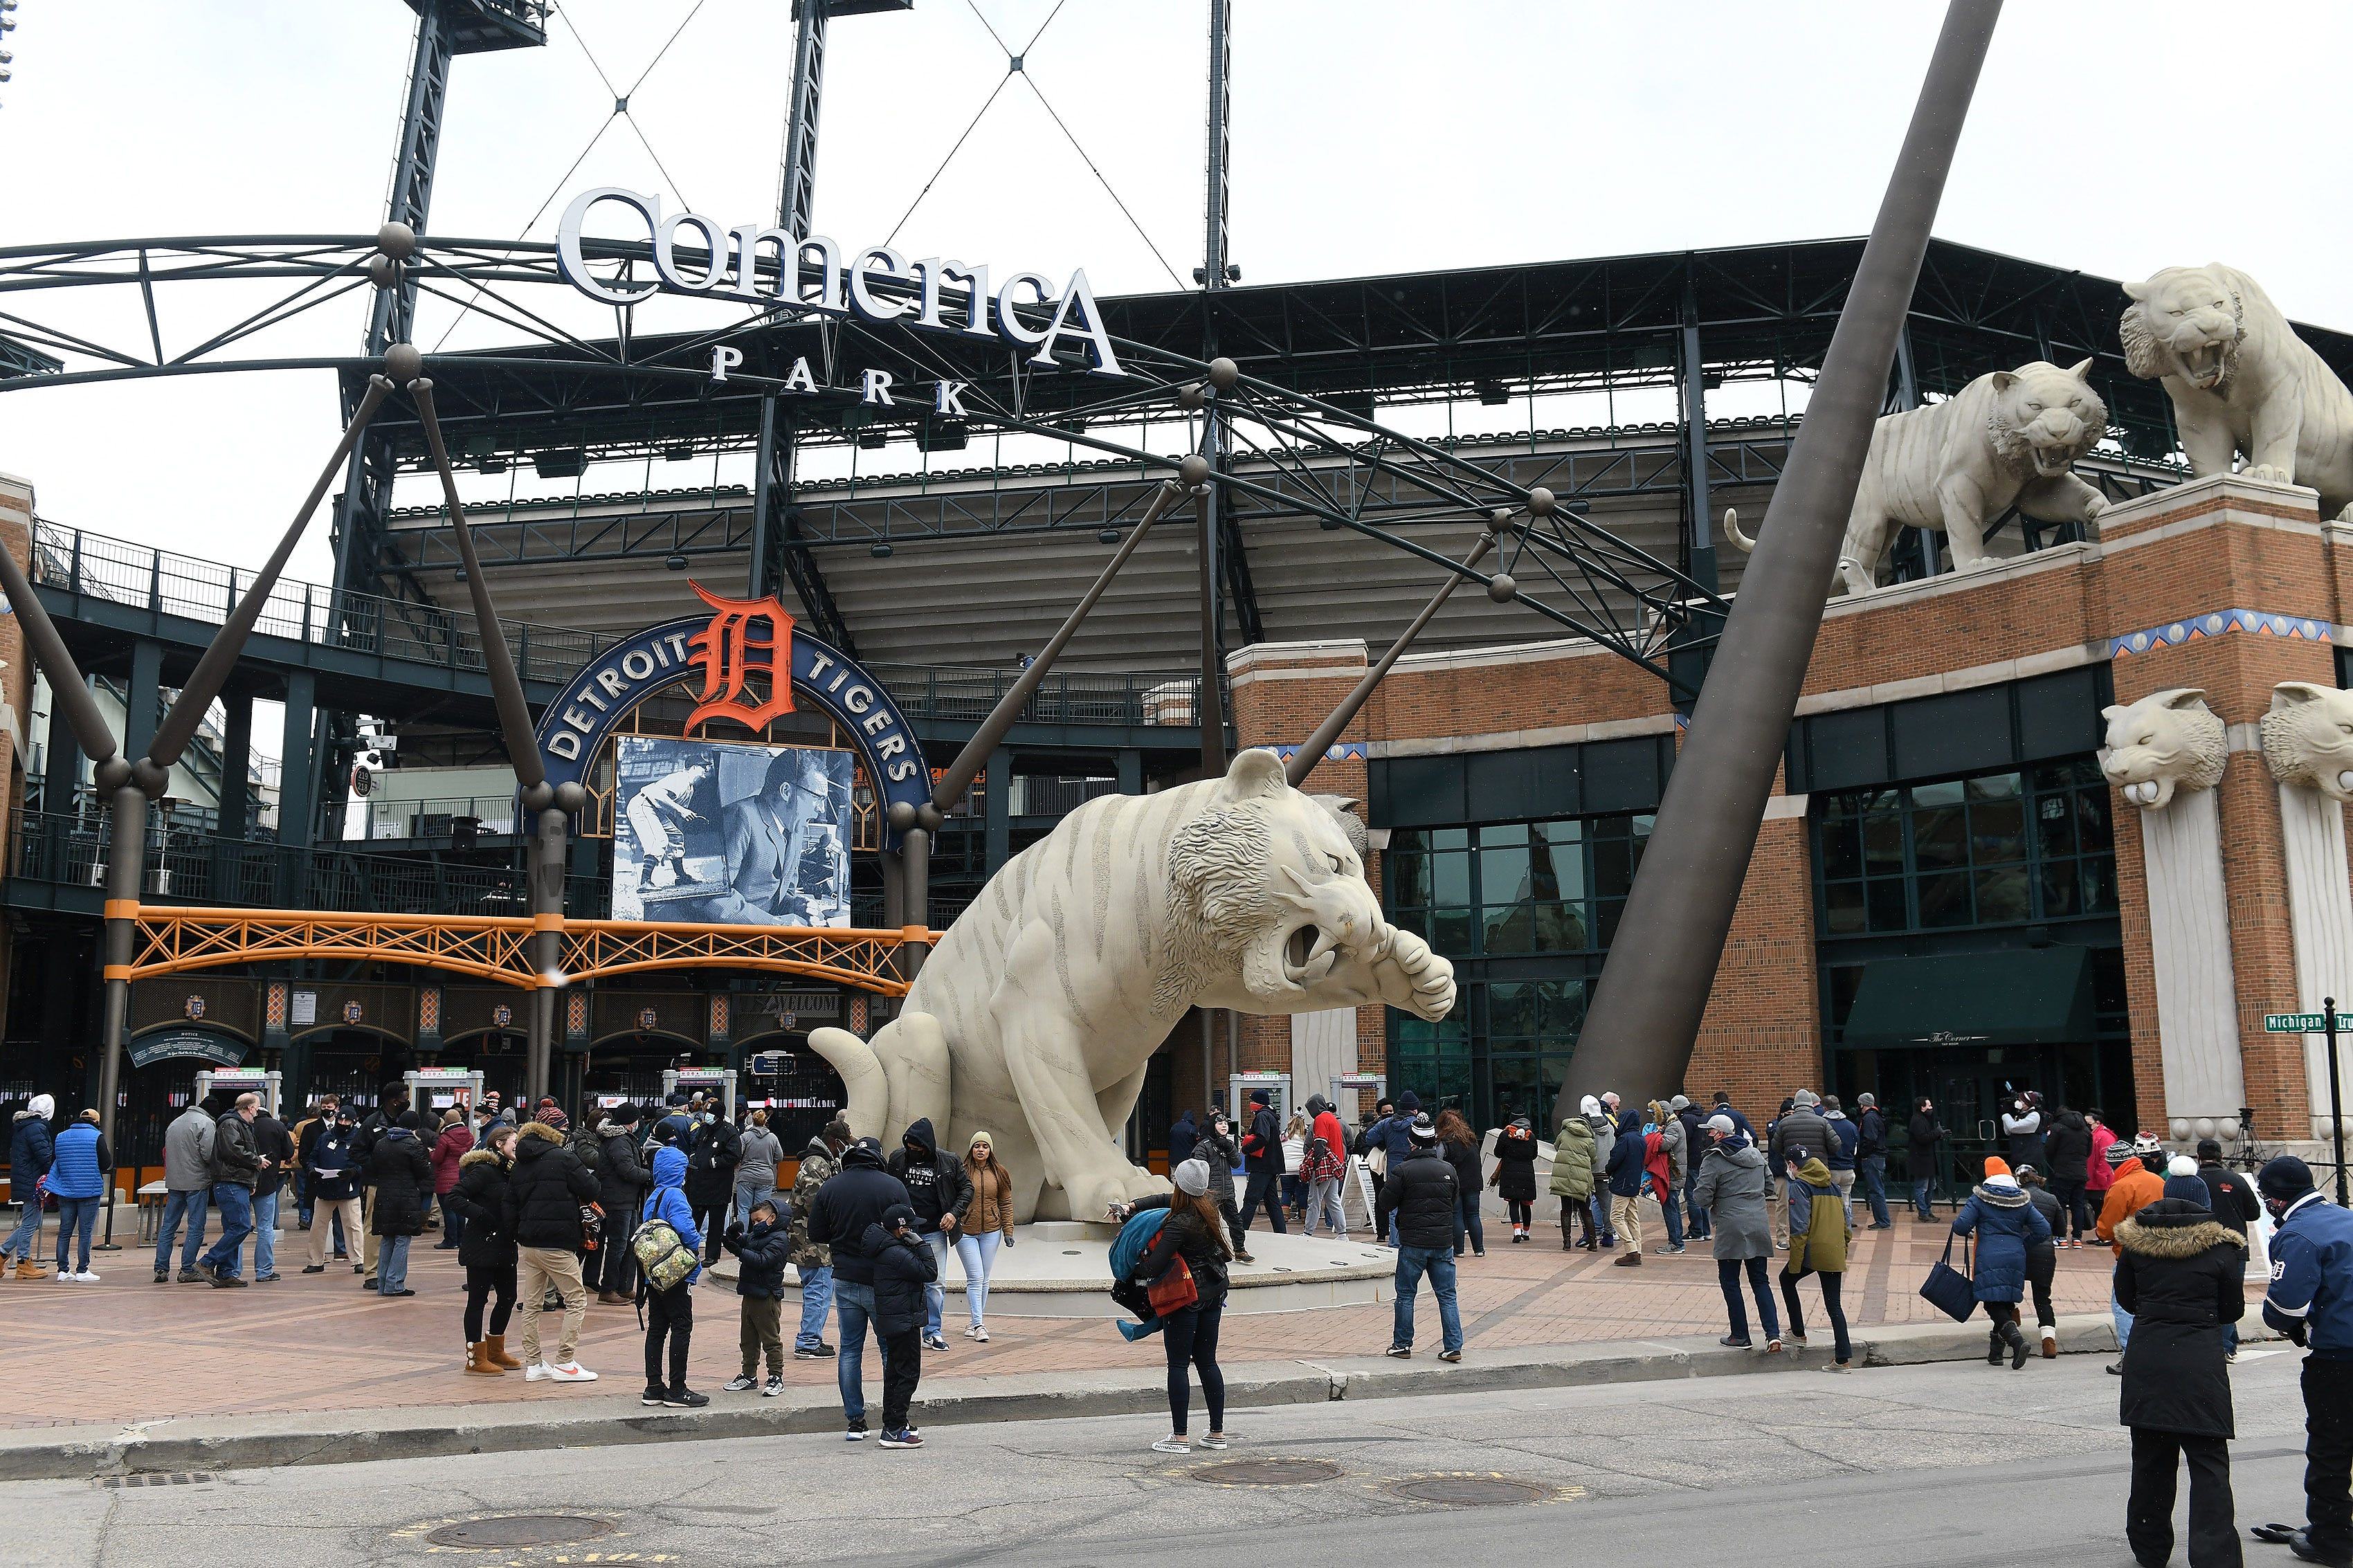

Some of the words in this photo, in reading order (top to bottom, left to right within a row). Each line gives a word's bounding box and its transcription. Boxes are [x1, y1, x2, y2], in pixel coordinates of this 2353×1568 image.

[710, 345, 969, 419] PARK
[683, 577, 797, 739] D
[548, 632, 687, 761] DETROIT
[806, 650, 916, 781] TIGERS
[358, 771, 368, 780] 219
[358, 783, 368, 792] 218
[2269, 1015, 2321, 1030] Michigan
[1929, 1032, 1943, 1043] The
[1943, 1031, 1971, 1042] Corner
[2271, 1259, 2286, 1281] D
